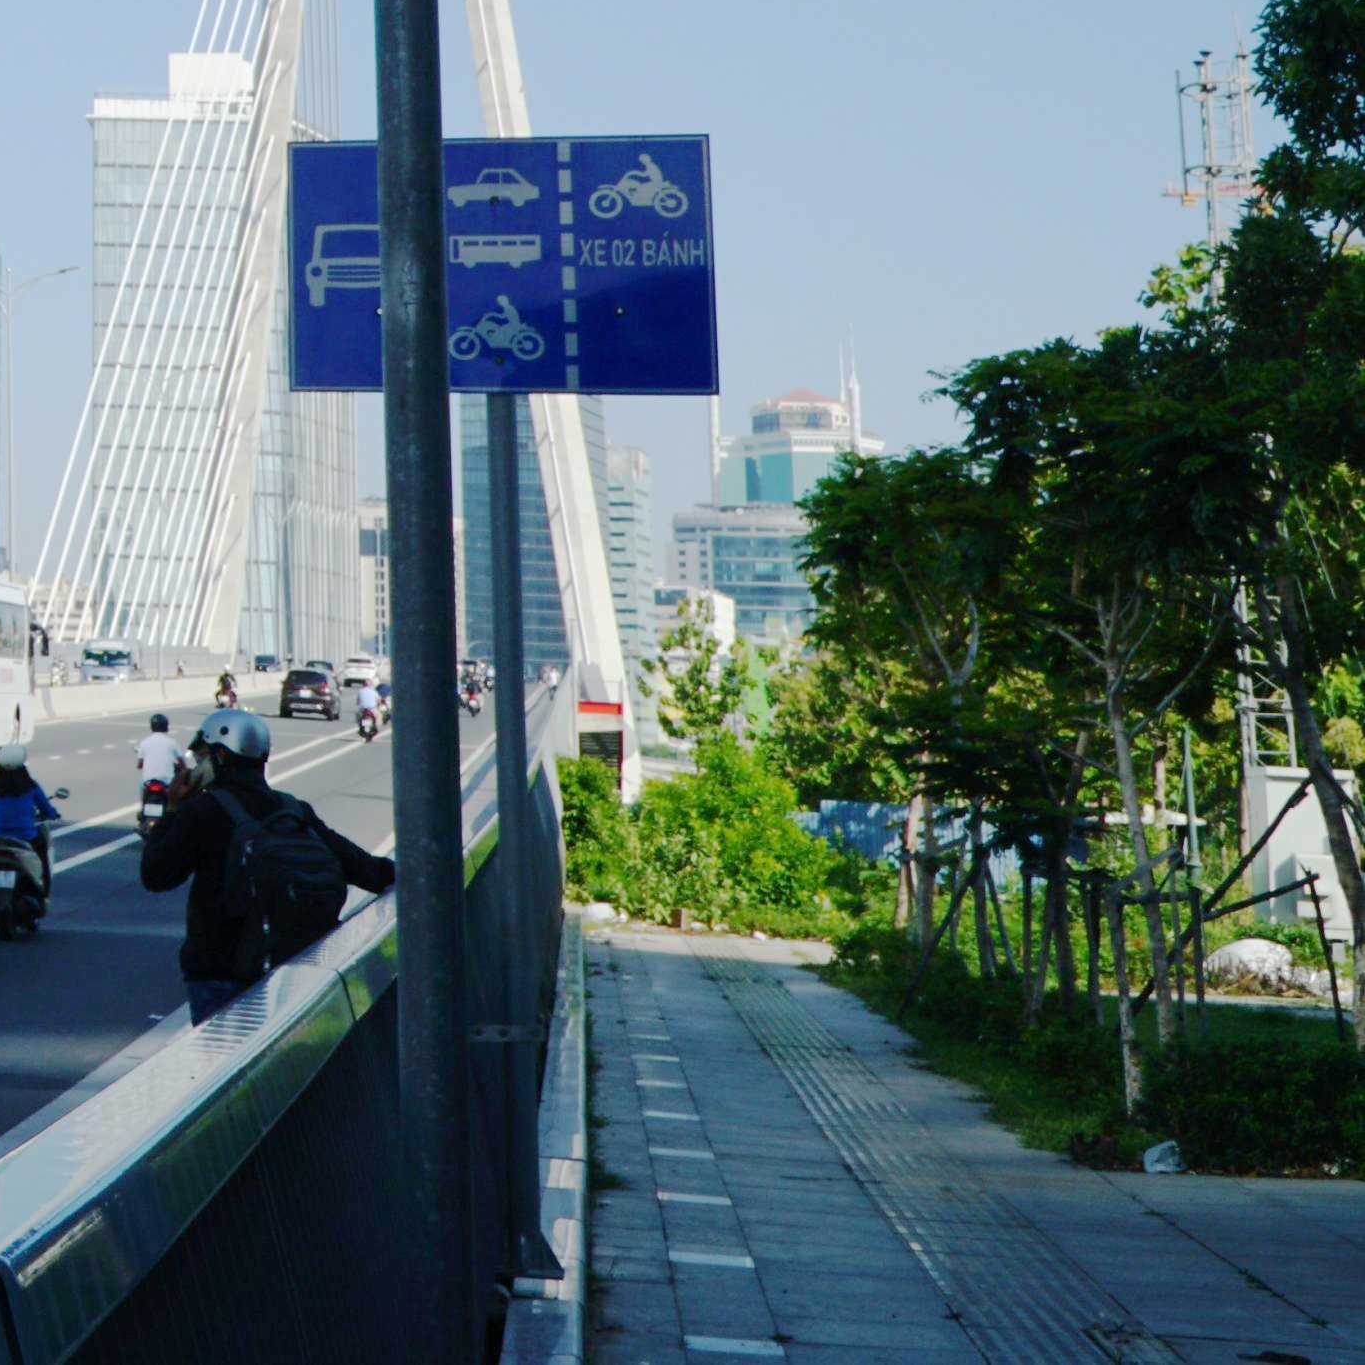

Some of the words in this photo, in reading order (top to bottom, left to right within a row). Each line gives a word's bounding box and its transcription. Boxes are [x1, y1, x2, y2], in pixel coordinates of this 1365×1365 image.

[578, 238, 608, 267] XE
[611, 238, 636, 267] 02
[641, 230, 704, 267] BÁNH
